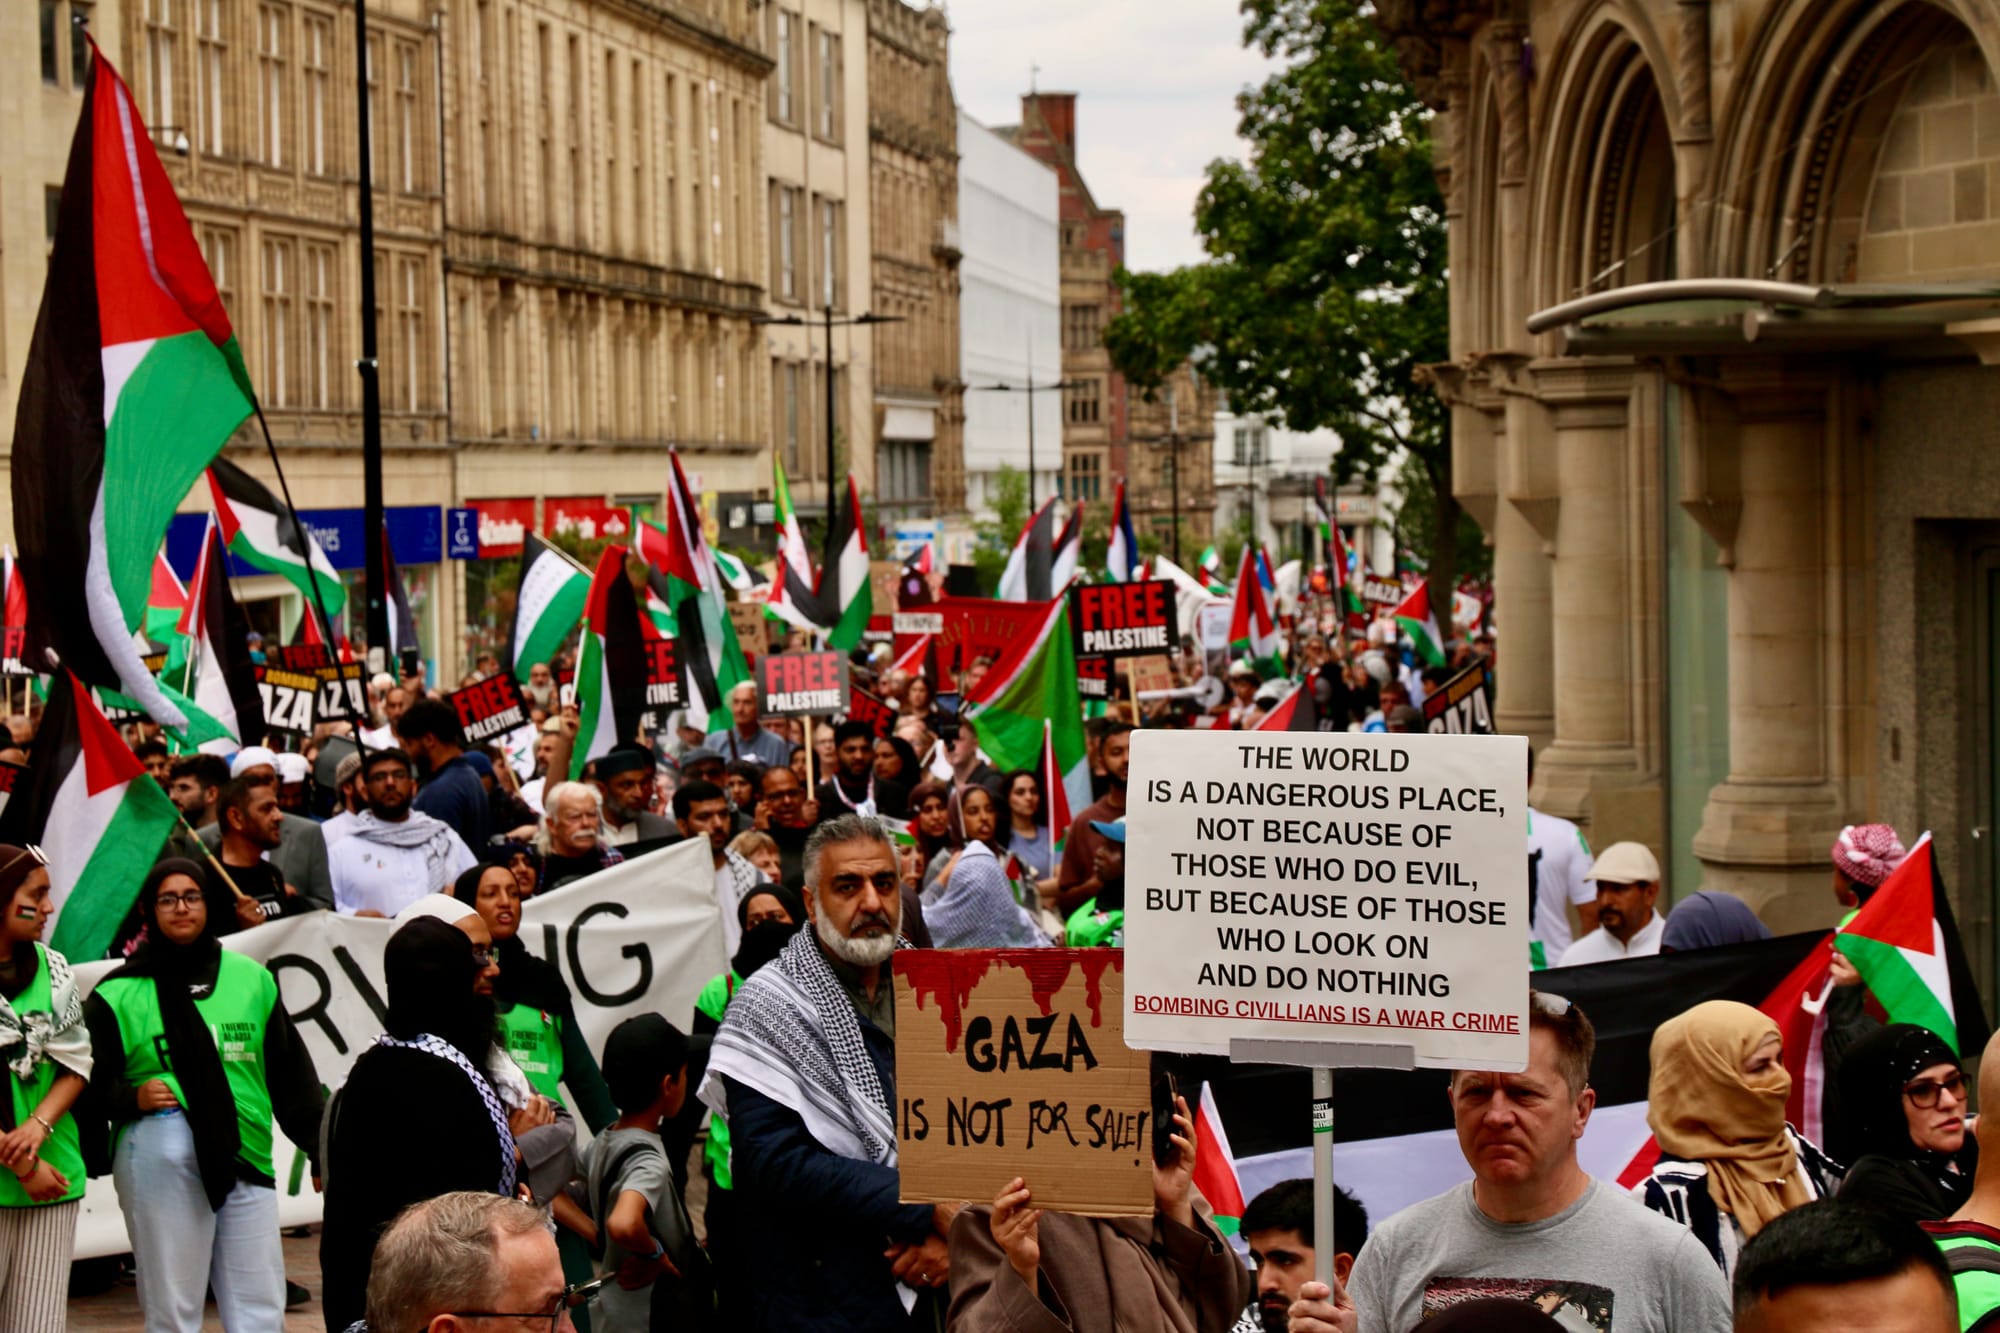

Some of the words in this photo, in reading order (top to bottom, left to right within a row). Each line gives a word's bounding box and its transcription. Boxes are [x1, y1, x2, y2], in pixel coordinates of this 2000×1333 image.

[1080, 582, 1167, 631] FREE
[1082, 625, 1168, 653] PALESTINE
[765, 652, 841, 694] FREE
[257, 682, 314, 732] AZA
[451, 671, 519, 728] FREE
[766, 688, 842, 713] PALESTINE
[463, 705, 524, 743] PALESTINE
[1239, 746, 1292, 769] THE
[1302, 748, 1409, 772] WORLD
[1148, 780, 1171, 802] IS
[1180, 781, 1197, 803] A
[1207, 782, 1389, 809] DANGEROUS
[1400, 787, 1504, 817] PLACE,
[1197, 818, 1254, 841] NOT
[1264, 820, 1402, 846] BECAUSE
[1412, 824, 1451, 848] OF
[1171, 853, 1266, 878] THOSE
[1275, 857, 1344, 881] WHO
[1355, 859, 1396, 883] DO
[1407, 861, 1477, 891] EVIL,
[1147, 888, 1201, 912] BUT
[1211, 891, 1347, 918] BECAUSE
[1358, 896, 1396, 920] OF
[1405, 898, 1506, 925] THOSE
[1217, 927, 1285, 952] WHO
[1295, 931, 1375, 957] LOOK
[1386, 935, 1428, 959] ON
[1198, 963, 1256, 987] AND
[1267, 966, 1307, 990] DO
[1318, 968, 1449, 997] NOTHING
[1134, 995, 1229, 1016] BOMBING
[1235, 999, 1346, 1023] CIVILLIANS
[1352, 1005, 1370, 1024] IS
[1377, 1008, 1390, 1026] A
[1396, 1010, 1444, 1028] WAR
[1452, 1012, 1519, 1033] CRIME
[965, 1012, 1099, 1074] GAZA
[903, 1098, 930, 1141] IS
[947, 1096, 1013, 1148] NOT
[1026, 1099, 1080, 1149] FOR
[1086, 1103, 1150, 1167] SALE!
